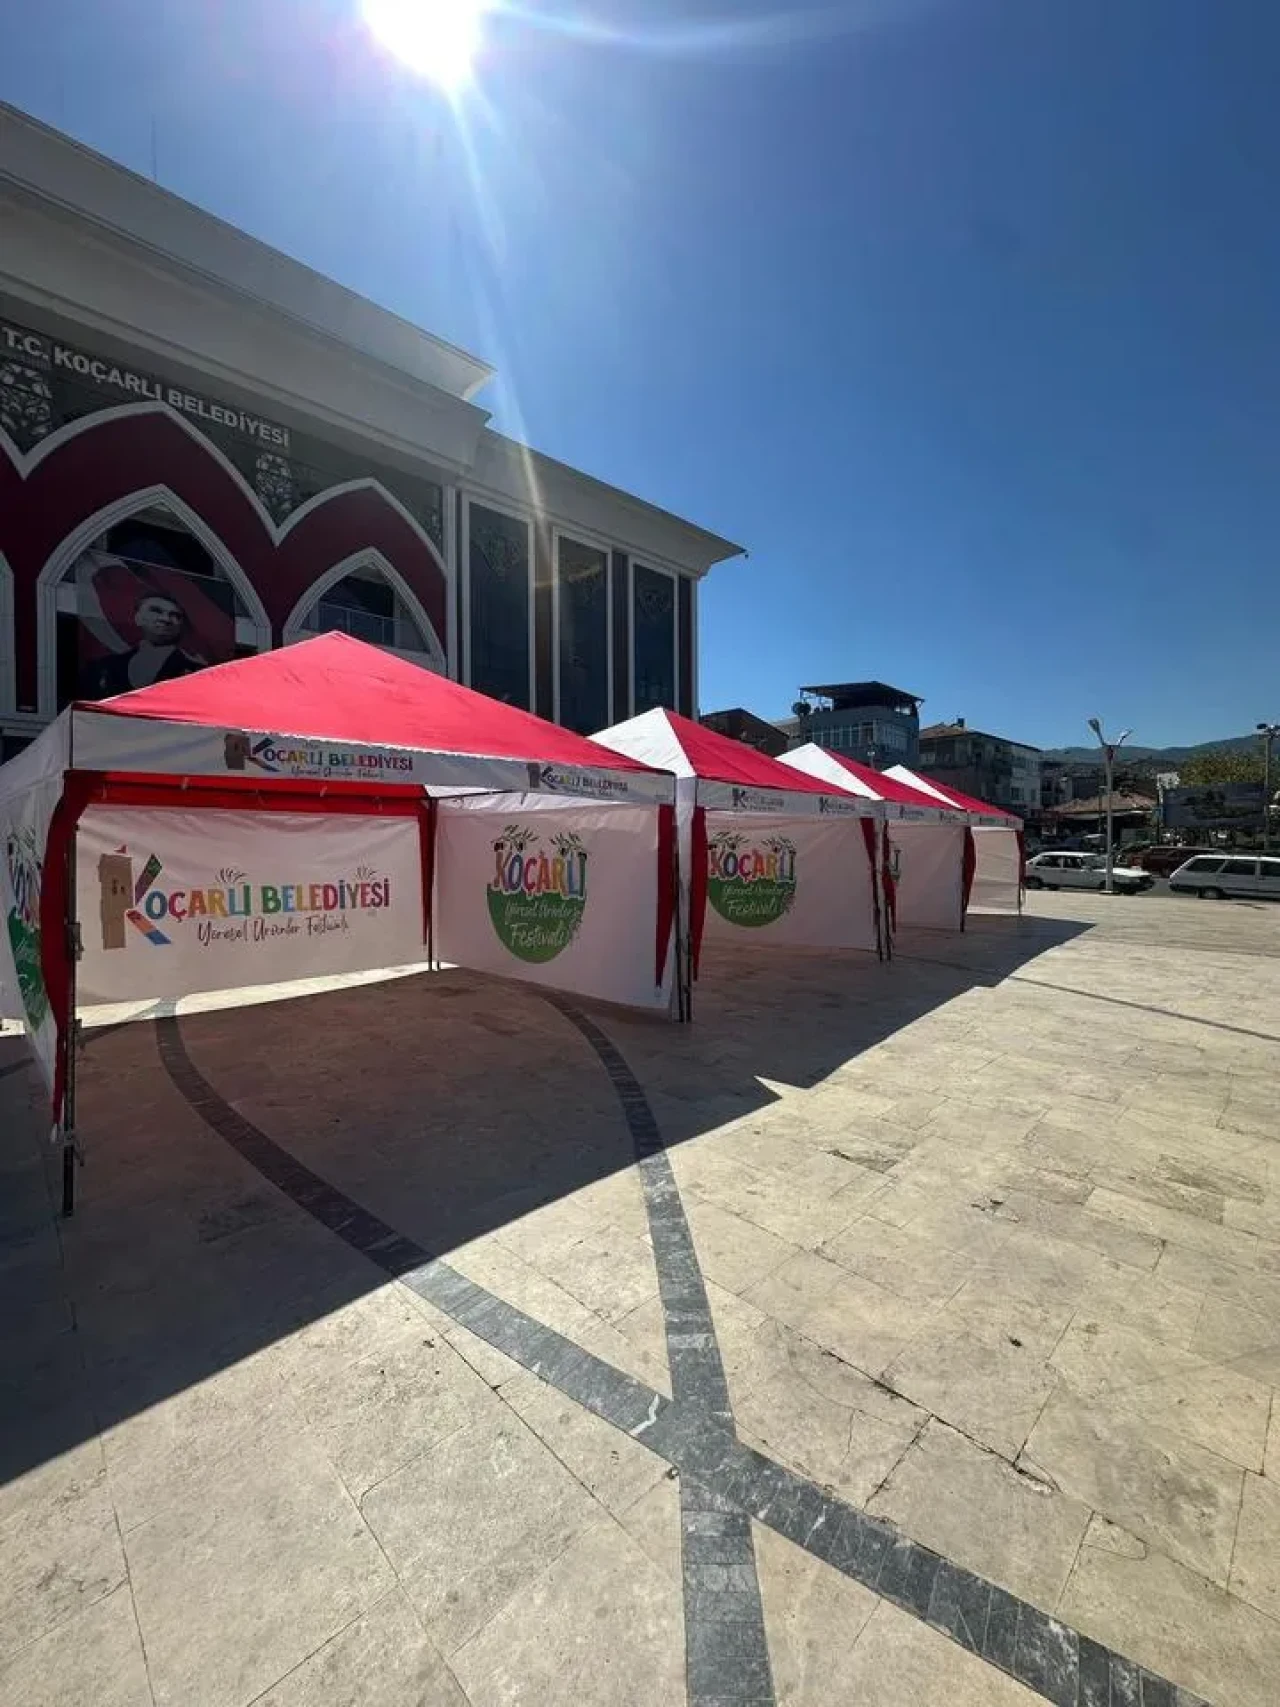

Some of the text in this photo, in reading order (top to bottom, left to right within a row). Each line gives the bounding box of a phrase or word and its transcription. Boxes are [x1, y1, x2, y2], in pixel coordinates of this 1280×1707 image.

[2, 326, 290, 448] T.C. KOÇARLI BELEDİYESİ
[329, 753, 413, 771] BELEDİYESİ
[493, 846, 588, 899] KOÇARLI
[709, 845, 797, 883] KOÇARLI
[98, 846, 252, 950] KOÇARLI
[260, 878, 391, 915] BELEDİYESİ
